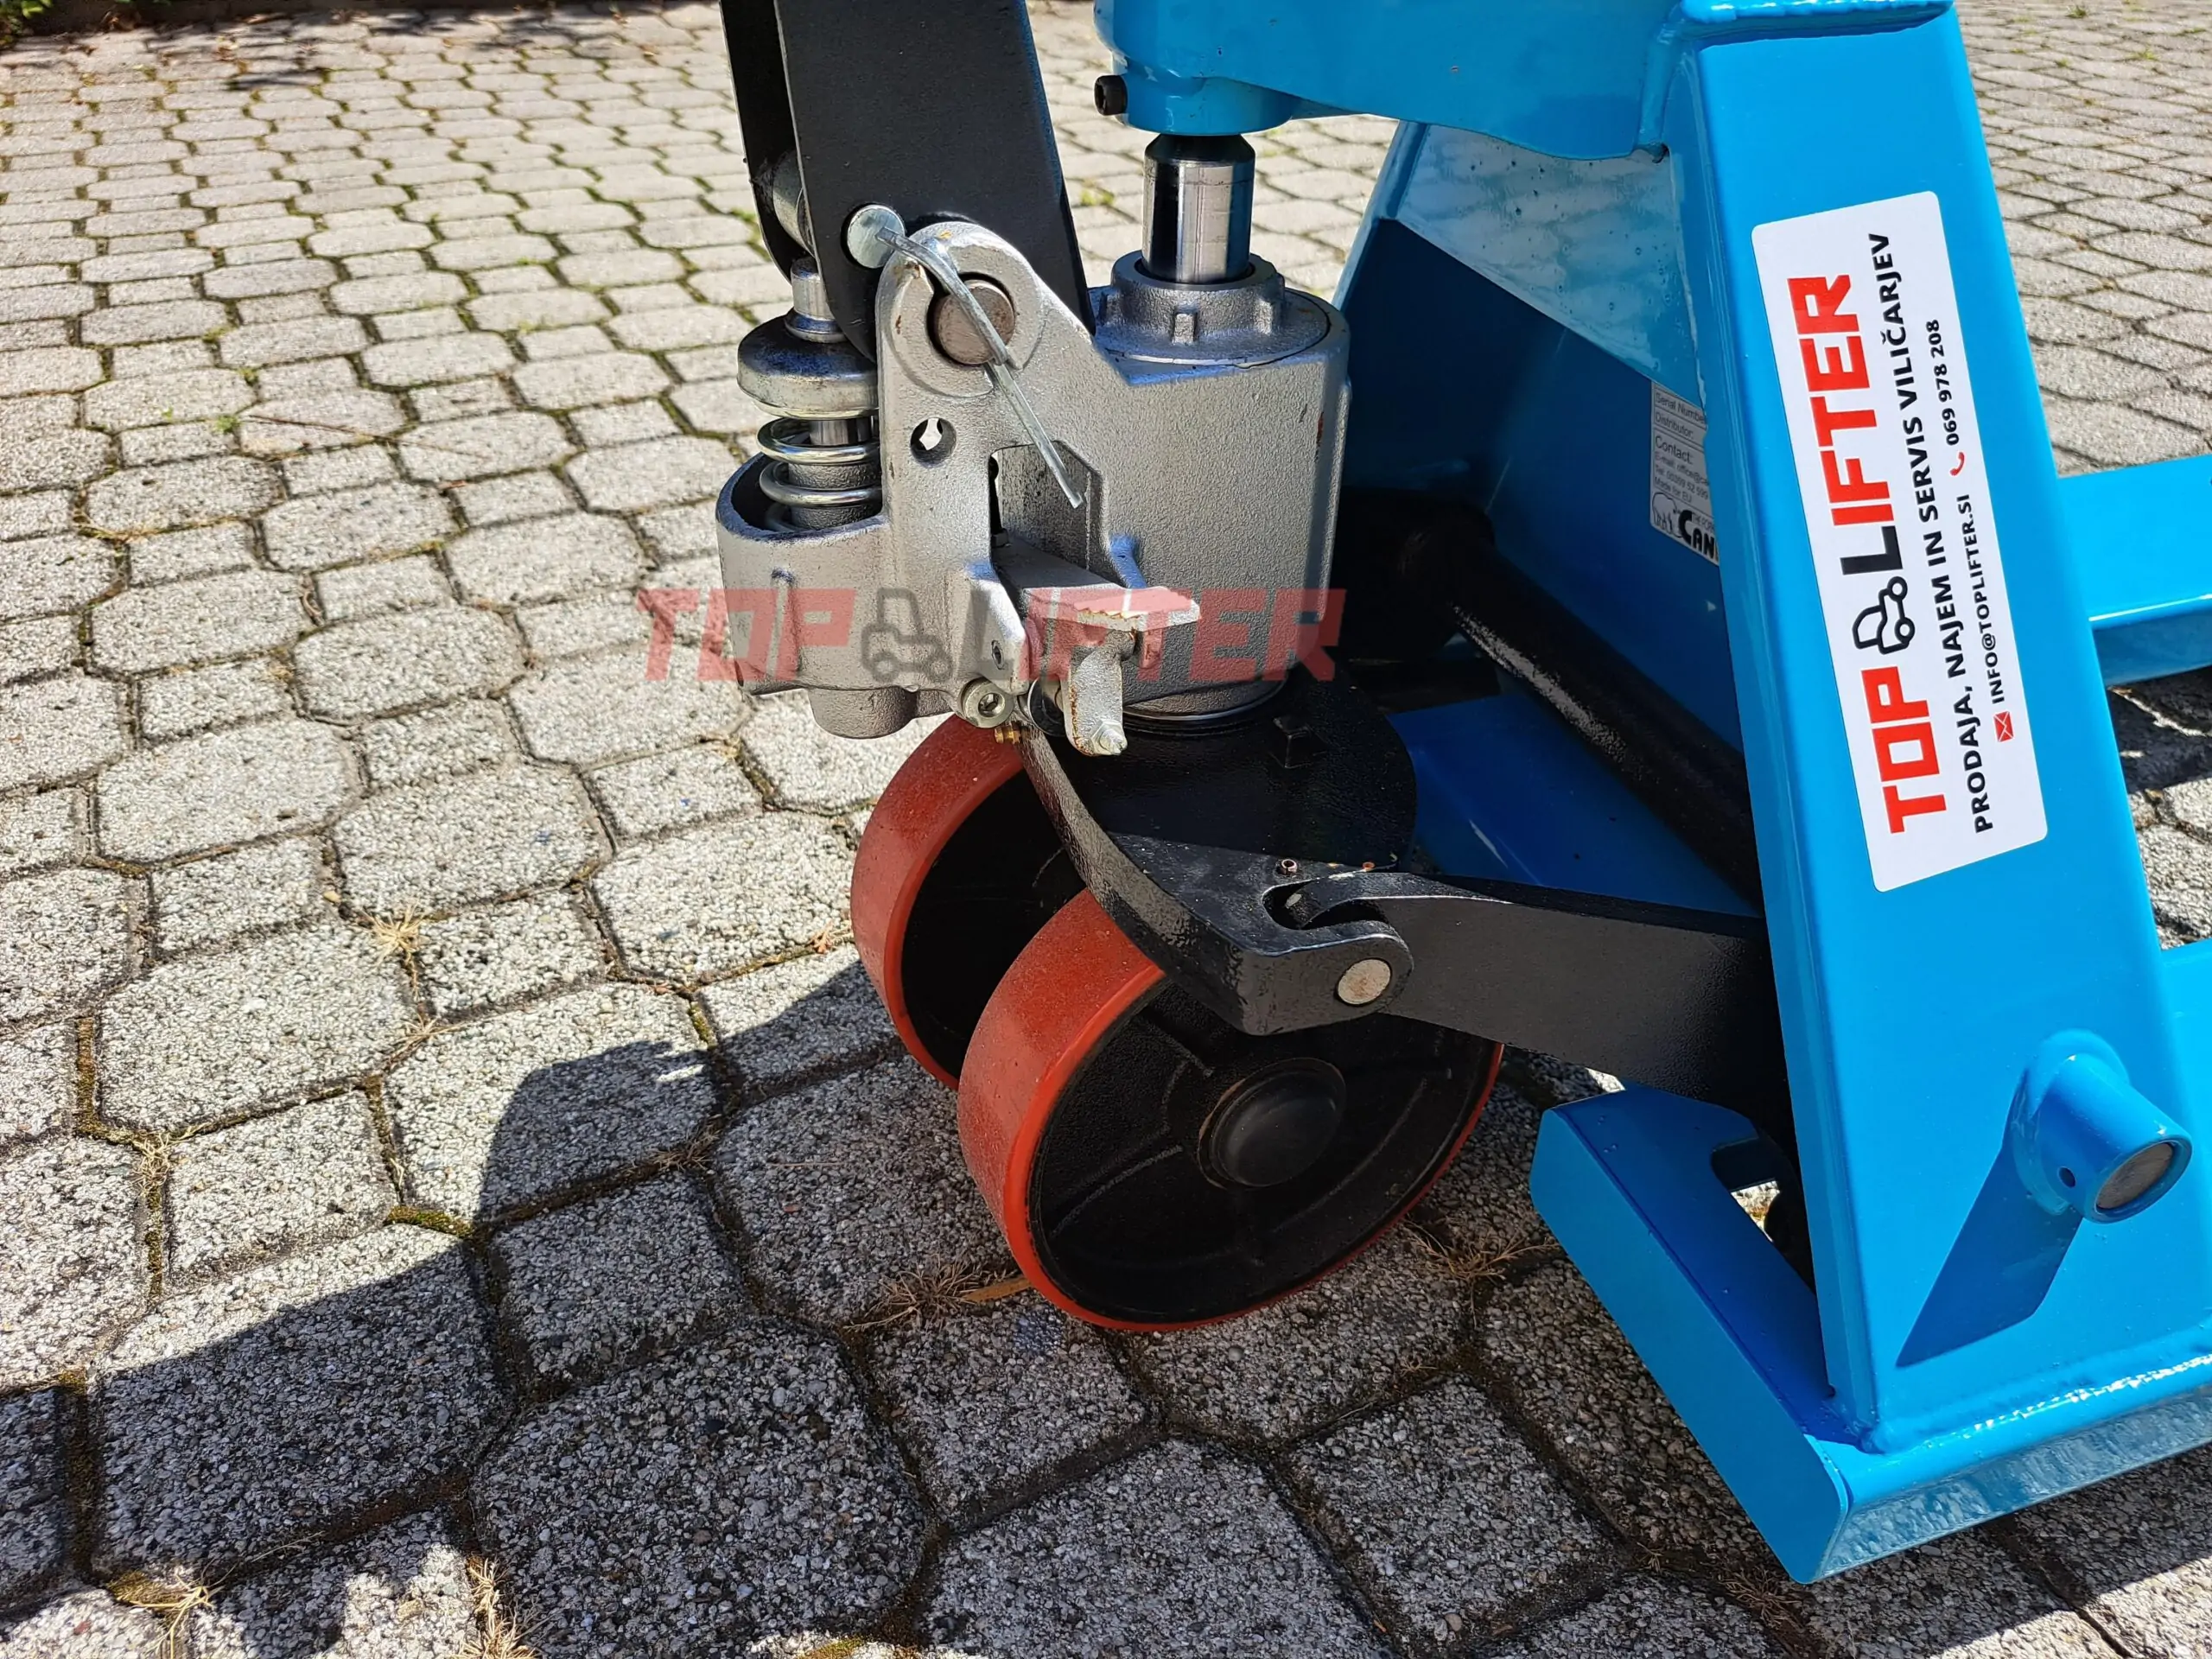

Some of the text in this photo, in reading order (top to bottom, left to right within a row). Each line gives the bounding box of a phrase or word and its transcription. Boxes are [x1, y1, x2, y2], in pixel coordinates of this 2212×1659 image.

[1656, 392, 1706, 423] Serial Numbe
[1926, 319, 1960, 446] 069 978 208
[1679, 510, 1719, 563] CAN
[1787, 274, 1947, 833] TOP LIFTER
[1868, 233, 1993, 833] PRODAJA, NAJEM IN SERVIS VILIČARJEV
[1956, 494, 2005, 703] INFO@TOPLIFTER.SI
